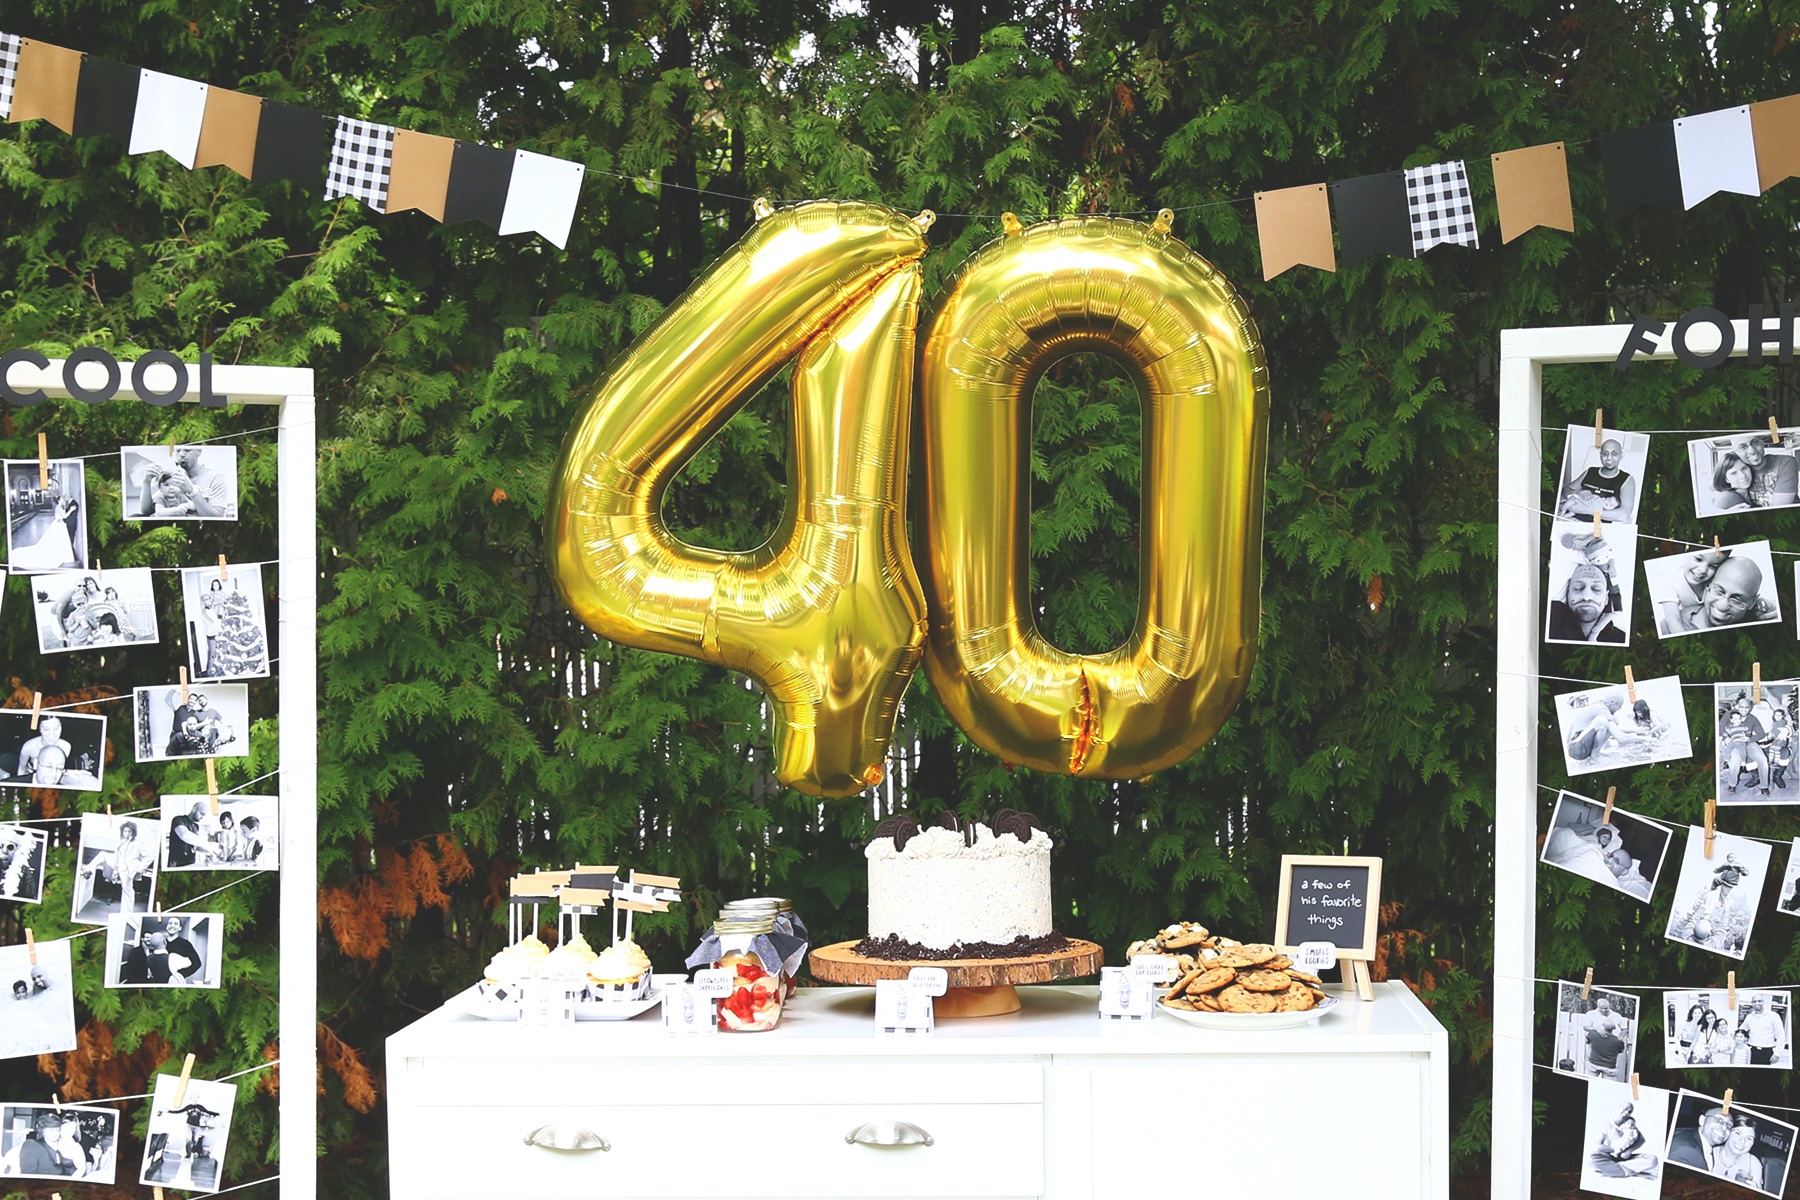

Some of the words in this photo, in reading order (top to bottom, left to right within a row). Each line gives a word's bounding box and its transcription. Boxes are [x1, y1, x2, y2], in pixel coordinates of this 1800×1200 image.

[0, 346, 227, 407] COOL
[549, 198, 1268, 798] 40
[1301, 879, 1309, 889] a
[1311, 879, 1333, 890] few
[1336, 879, 1352, 889] of
[1301, 896, 1317, 905] his
[1321, 893, 1363, 908] favorite
[1307, 913, 1344, 930] things
